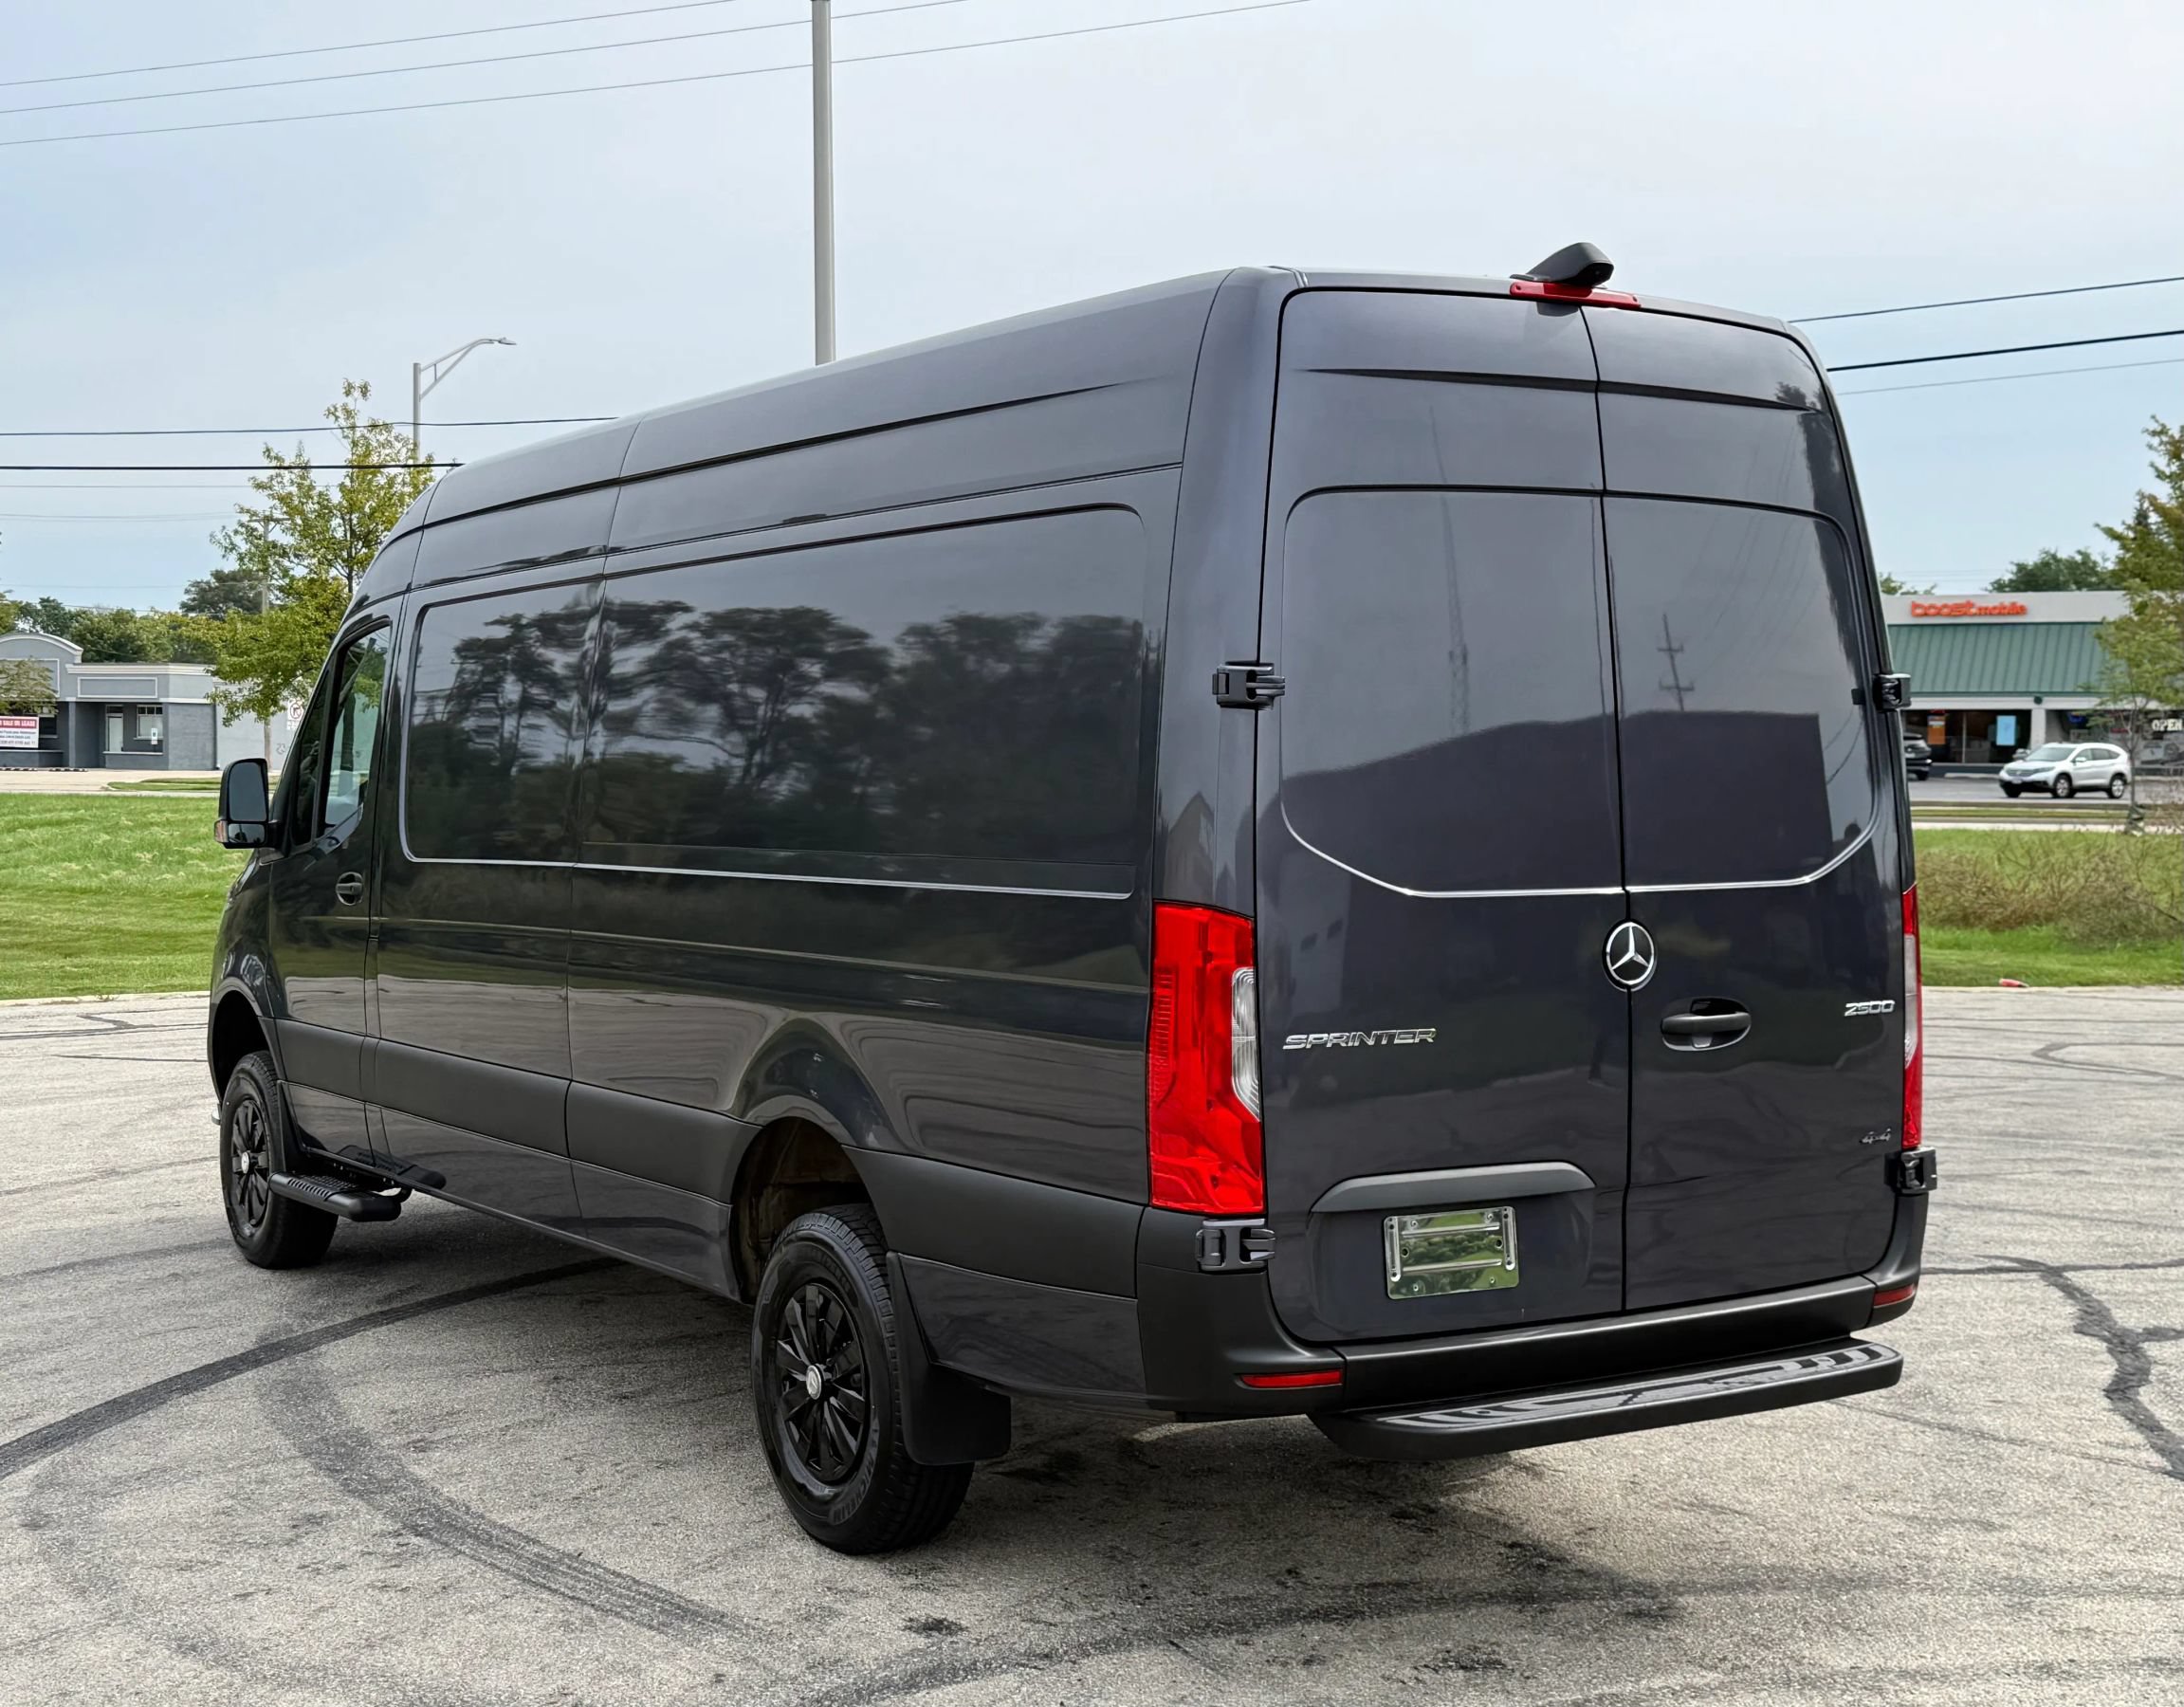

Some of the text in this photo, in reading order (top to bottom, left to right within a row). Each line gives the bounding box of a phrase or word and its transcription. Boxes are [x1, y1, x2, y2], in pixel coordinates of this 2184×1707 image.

[2151, 718, 2183, 731] OPEN
[1844, 1000, 1895, 1017] 2500
[1283, 1028, 1437, 1050] SPRINTER
[833, 1452, 874, 1523] MICHELIN
